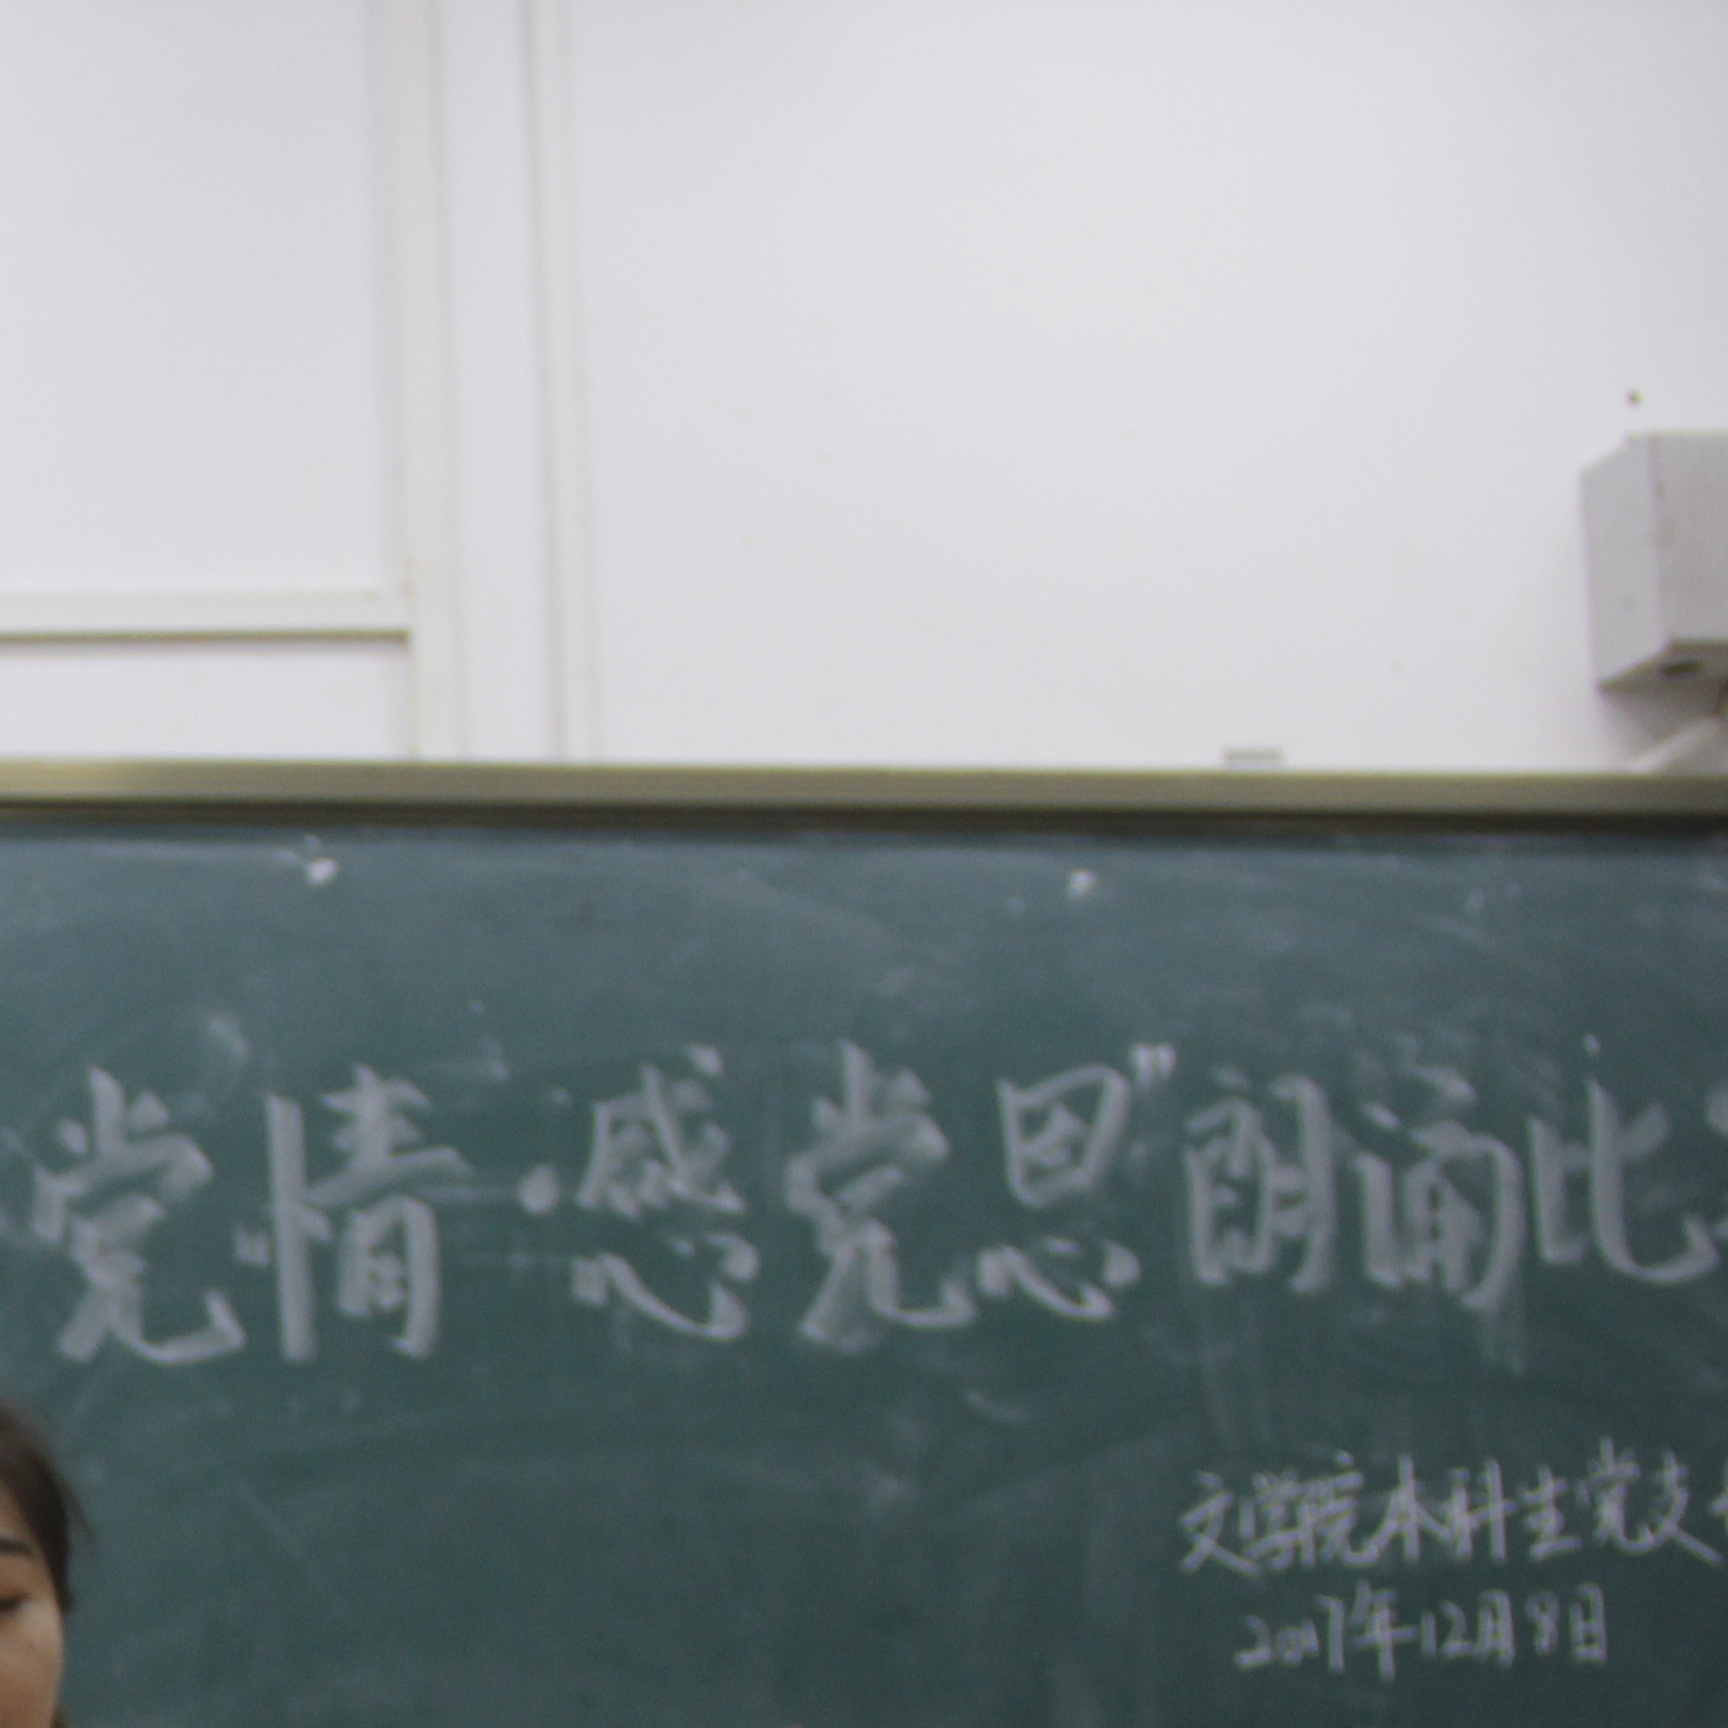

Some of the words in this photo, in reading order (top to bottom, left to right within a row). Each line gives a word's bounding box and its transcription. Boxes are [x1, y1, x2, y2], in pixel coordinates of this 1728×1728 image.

[1178, 1435, 1728, 1577] 文学院本科生党支
